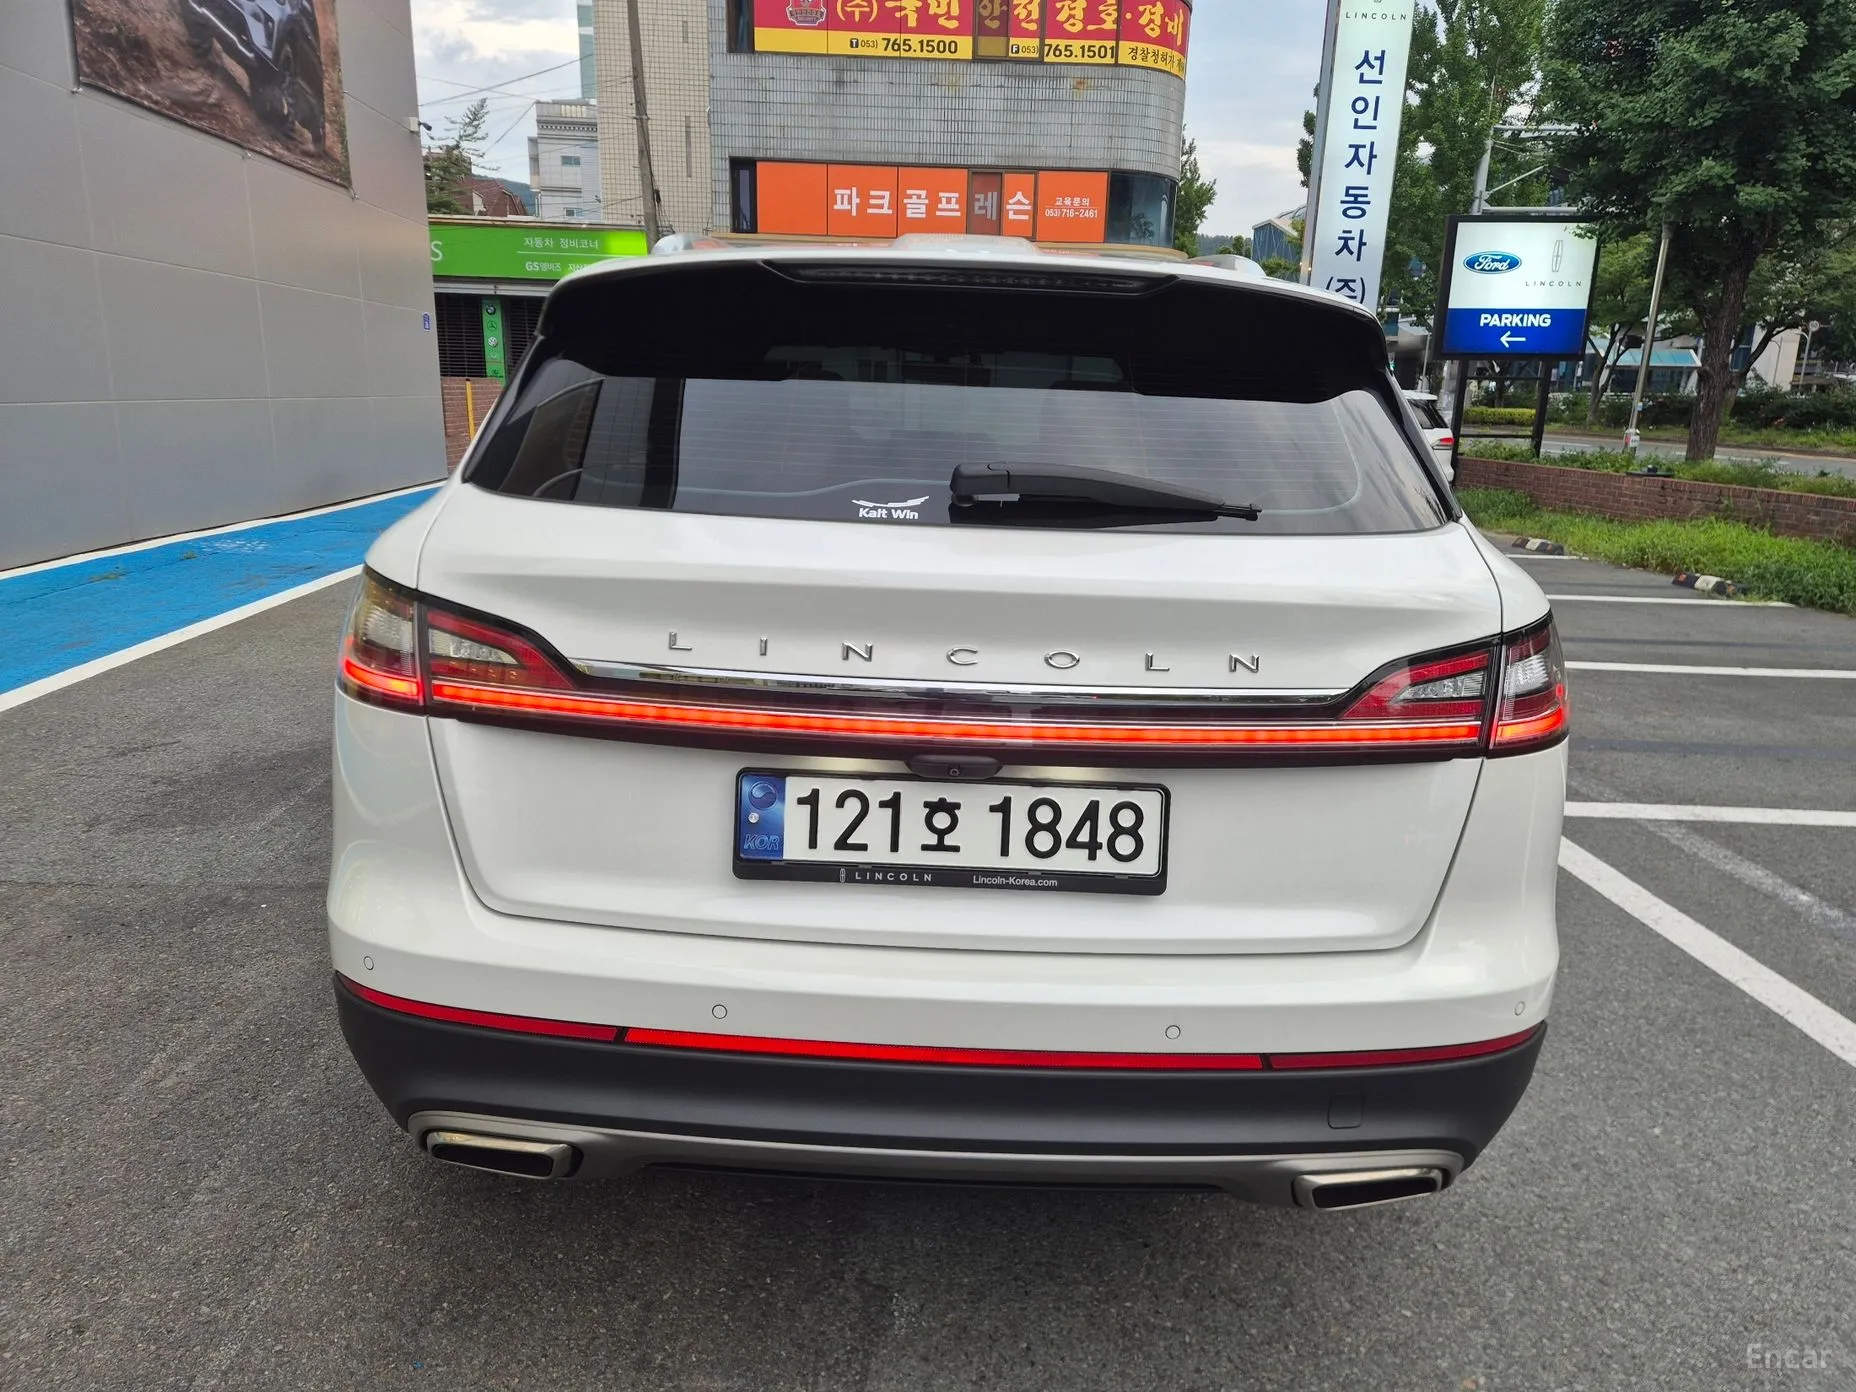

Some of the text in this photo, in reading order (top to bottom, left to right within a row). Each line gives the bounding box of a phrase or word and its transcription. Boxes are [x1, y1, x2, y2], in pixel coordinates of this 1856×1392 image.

[1345, 12, 1407, 20] LINCOLN
[860, 39, 878, 49] 053)
[882, 38, 958, 54] 765.1500
[1021, 45, 1039, 54] 053)
[1044, 44, 1115, 59] 765.1501
[523, 238, 598, 249] 자동차 정비코너
[1474, 254, 1511, 271] Ford
[1480, 313, 1551, 327] PARKING
[891, 509, 919, 519] Win
[668, 631, 1260, 673] LINCOLN
[797, 787, 1145, 863] 121호 1848
[744, 834, 780, 850] KOR
[856, 872, 1058, 887] LINCOLN Lincoln-Korea.com
